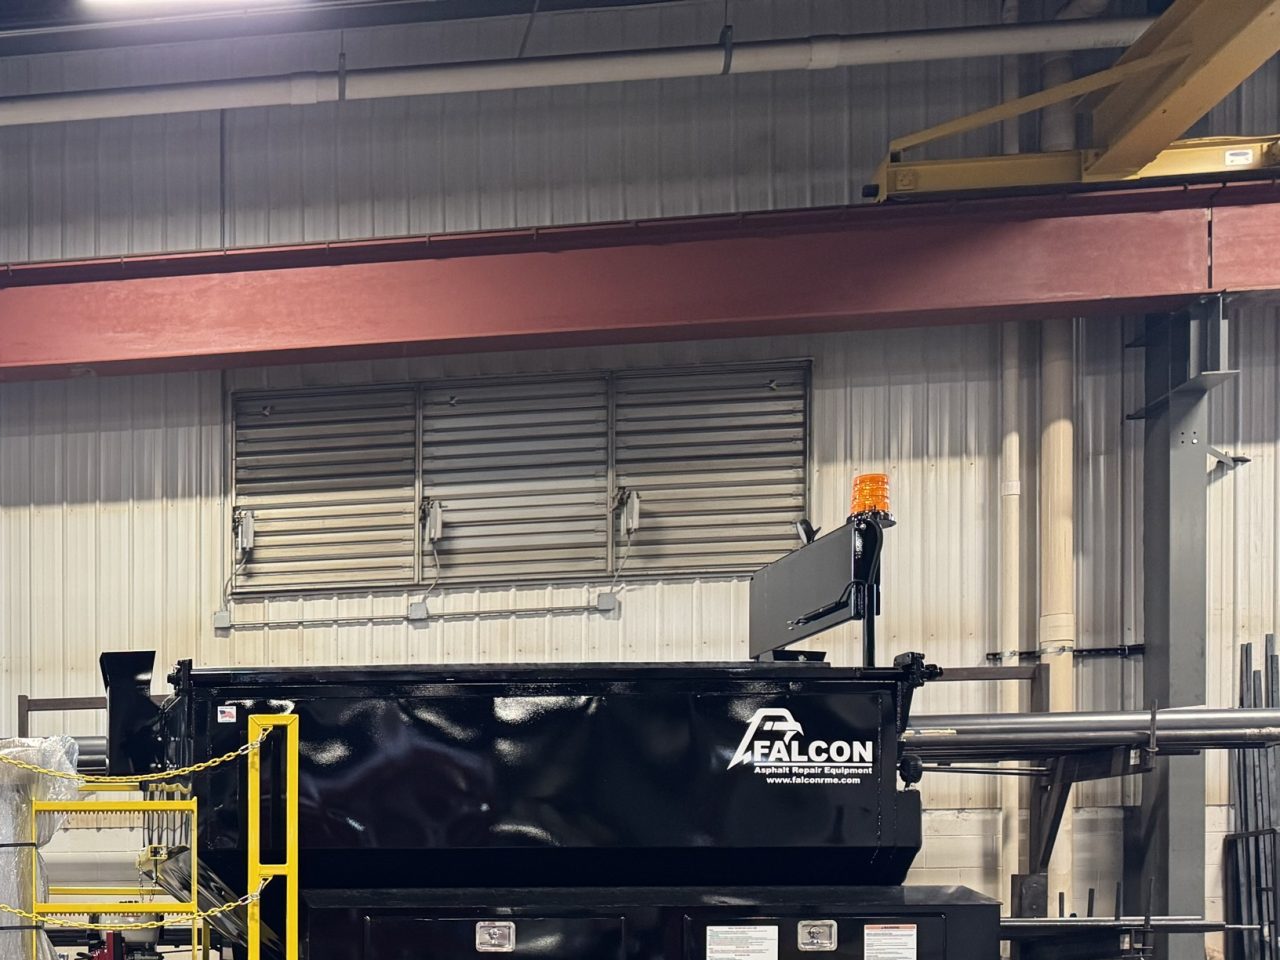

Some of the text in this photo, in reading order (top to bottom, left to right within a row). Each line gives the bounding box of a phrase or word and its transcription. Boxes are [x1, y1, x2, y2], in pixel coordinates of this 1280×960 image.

[754, 740, 873, 762] FALCON
[754, 766, 873, 775] Asphalt Repair Equipment
[766, 776, 861, 785] www.falconrme.com
